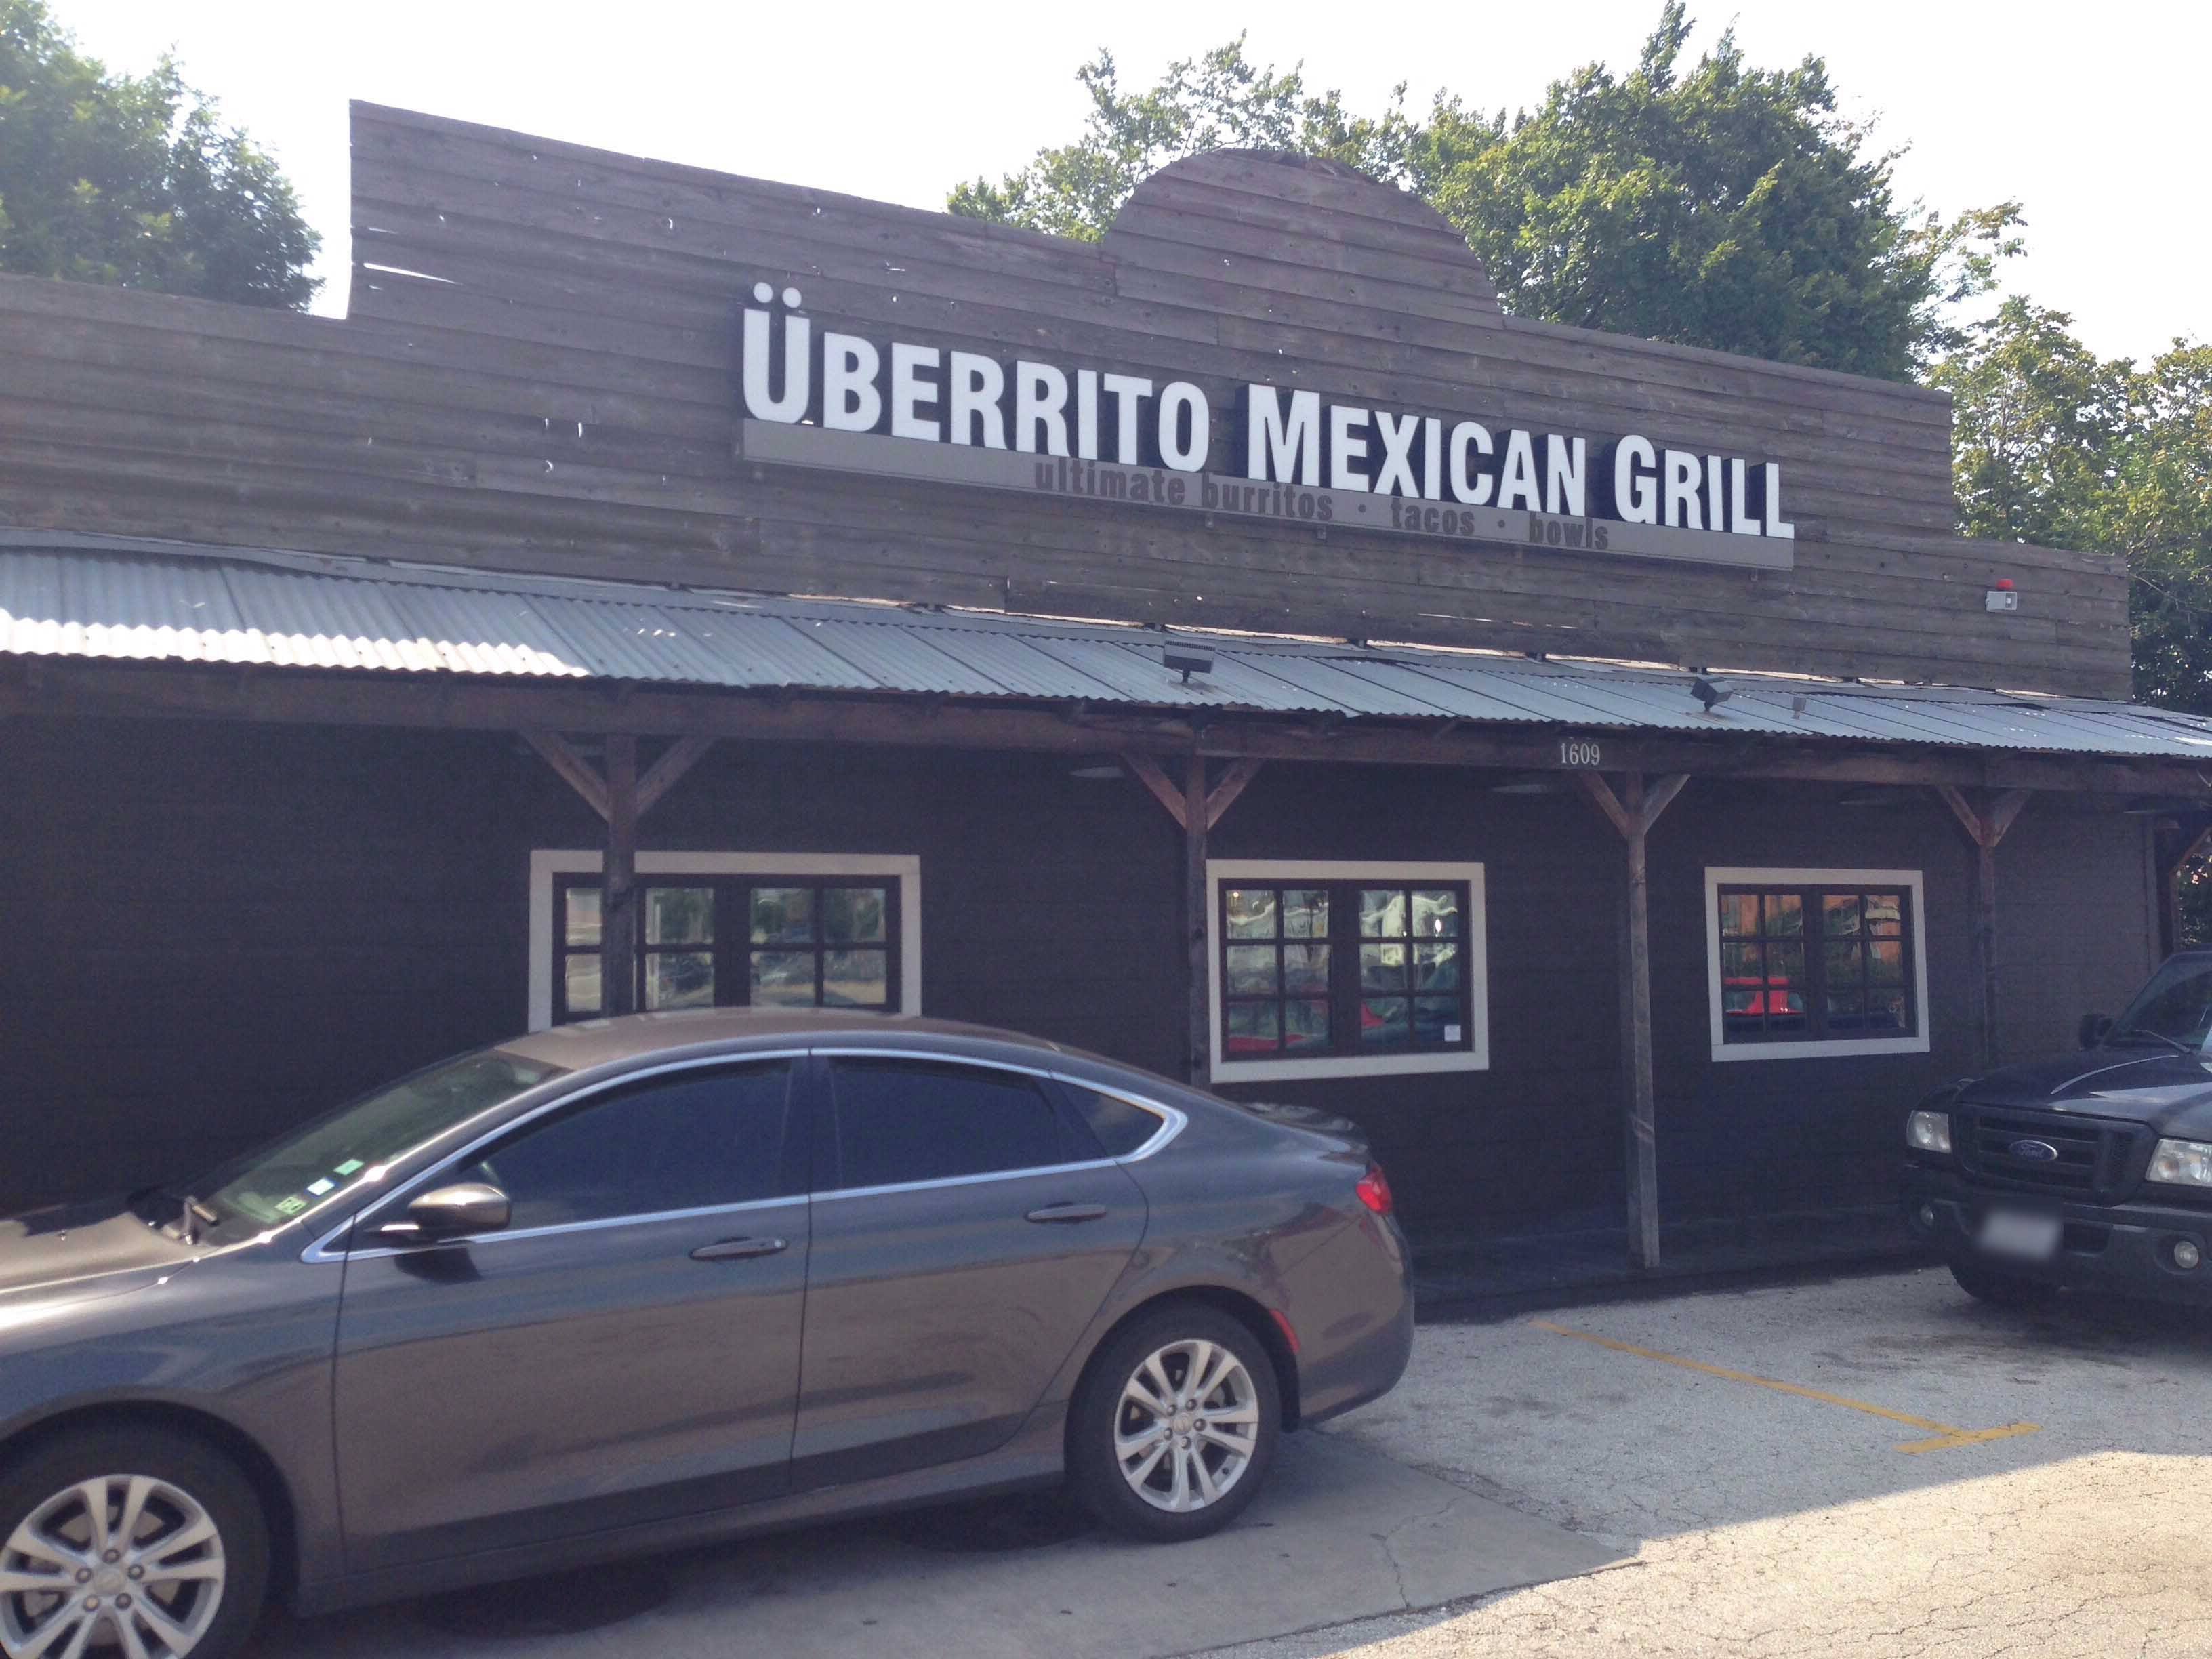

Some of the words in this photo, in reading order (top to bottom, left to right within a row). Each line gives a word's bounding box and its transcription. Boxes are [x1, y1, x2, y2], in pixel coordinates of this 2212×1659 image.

[743, 281, 1210, 473] ÜBERRITO
[1247, 383, 1586, 518] MEXICAN
[1614, 434, 1795, 539] GRILL
[1034, 456, 1186, 506] ultimate
[1201, 472, 1333, 521] burritos
[1391, 497, 1475, 536] tacos
[1529, 510, 1609, 550] bowls
[1561, 742, 1601, 766] 1609
